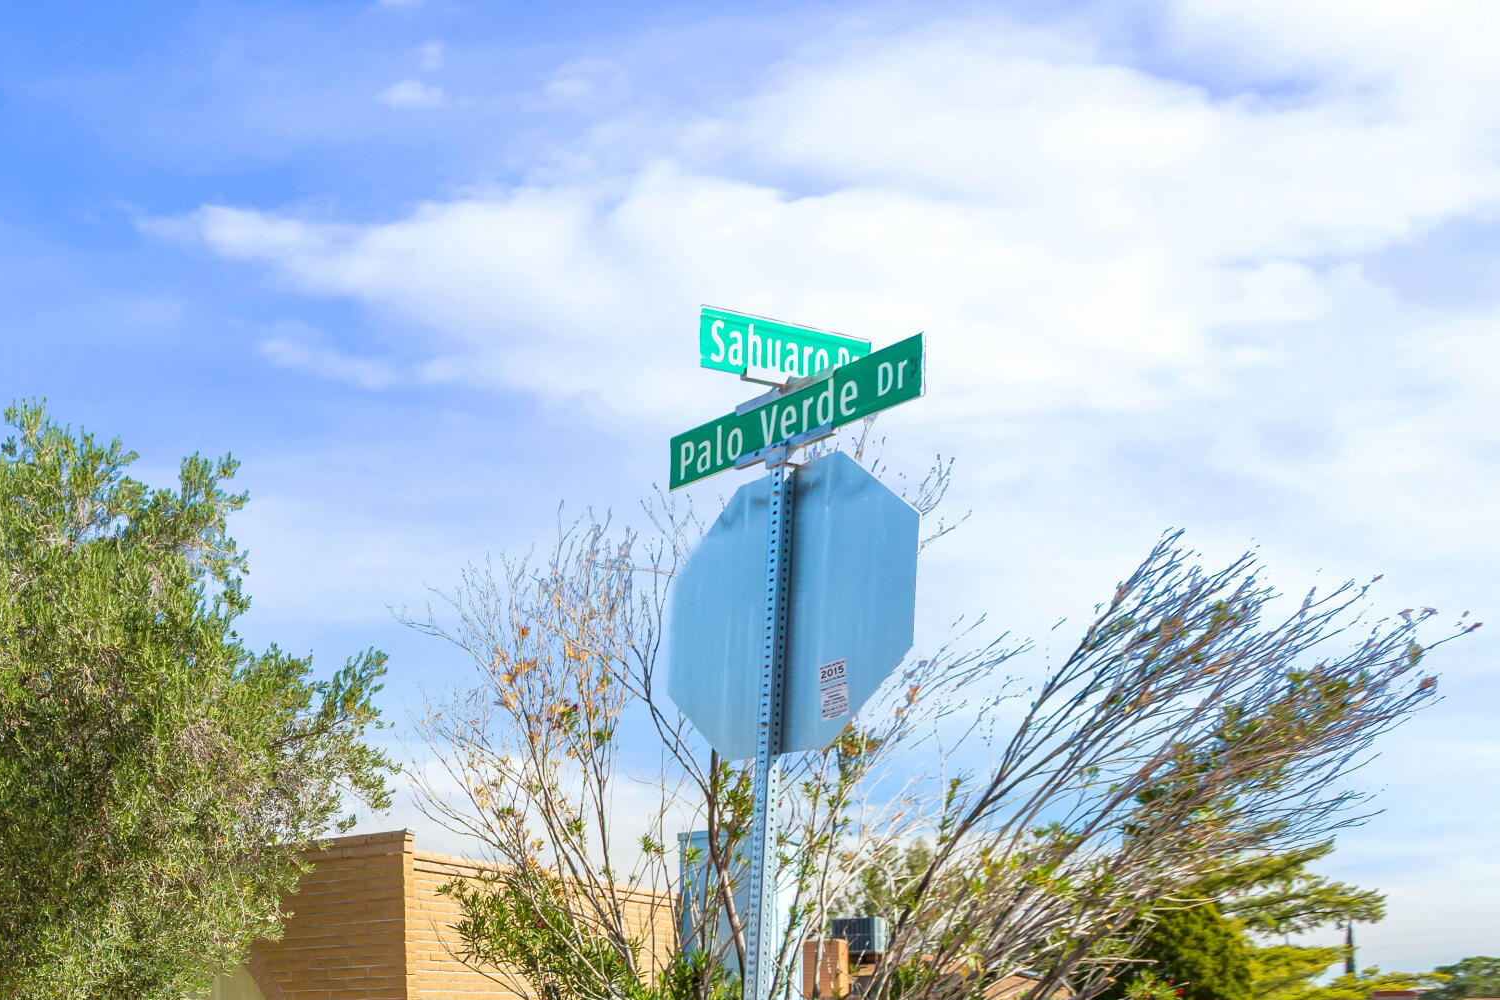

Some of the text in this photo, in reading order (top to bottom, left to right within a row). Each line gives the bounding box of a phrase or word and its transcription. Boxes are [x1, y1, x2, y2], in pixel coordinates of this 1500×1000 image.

[710, 320, 830, 377] Sahuaro
[679, 358, 909, 480] Palo Verde Dr
[820, 665, 845, 679] 2015
